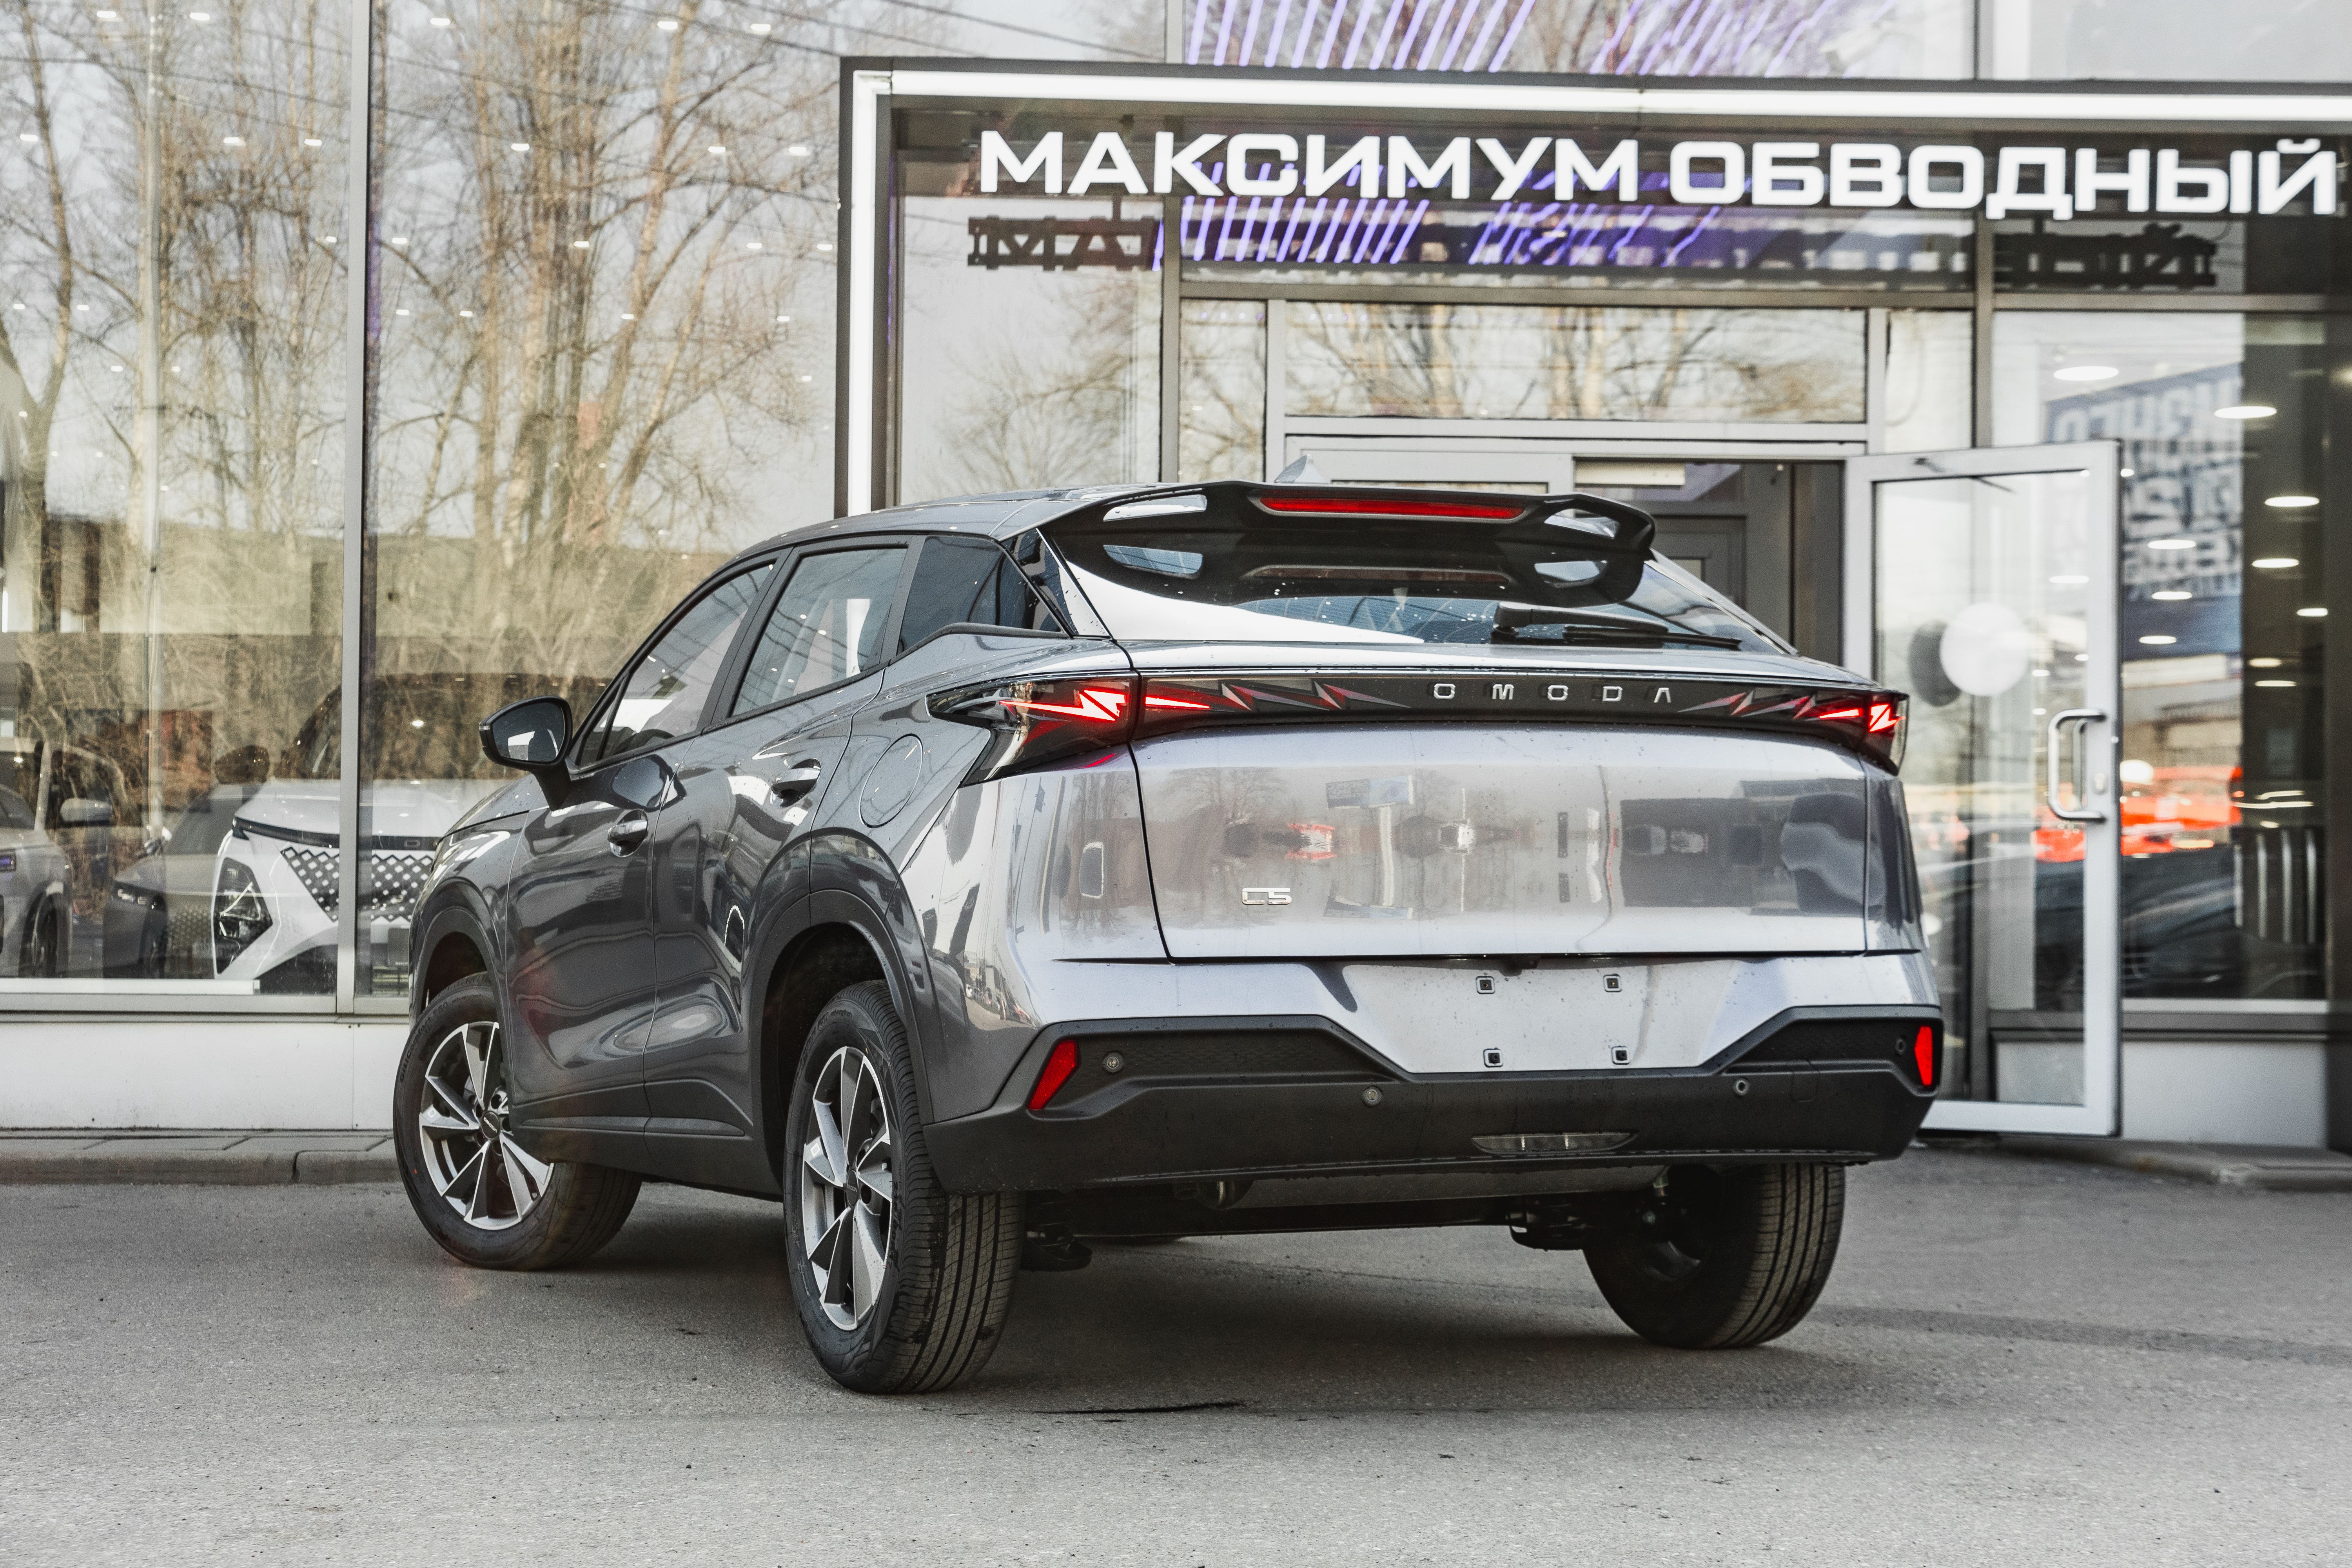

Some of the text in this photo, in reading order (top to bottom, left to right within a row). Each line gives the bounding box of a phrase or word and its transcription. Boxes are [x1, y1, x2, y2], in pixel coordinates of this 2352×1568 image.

[980, 131, 2336, 220] МАКСИМУМ ОБВОДНЫЙ
[1241, 887, 1292, 905] C5
